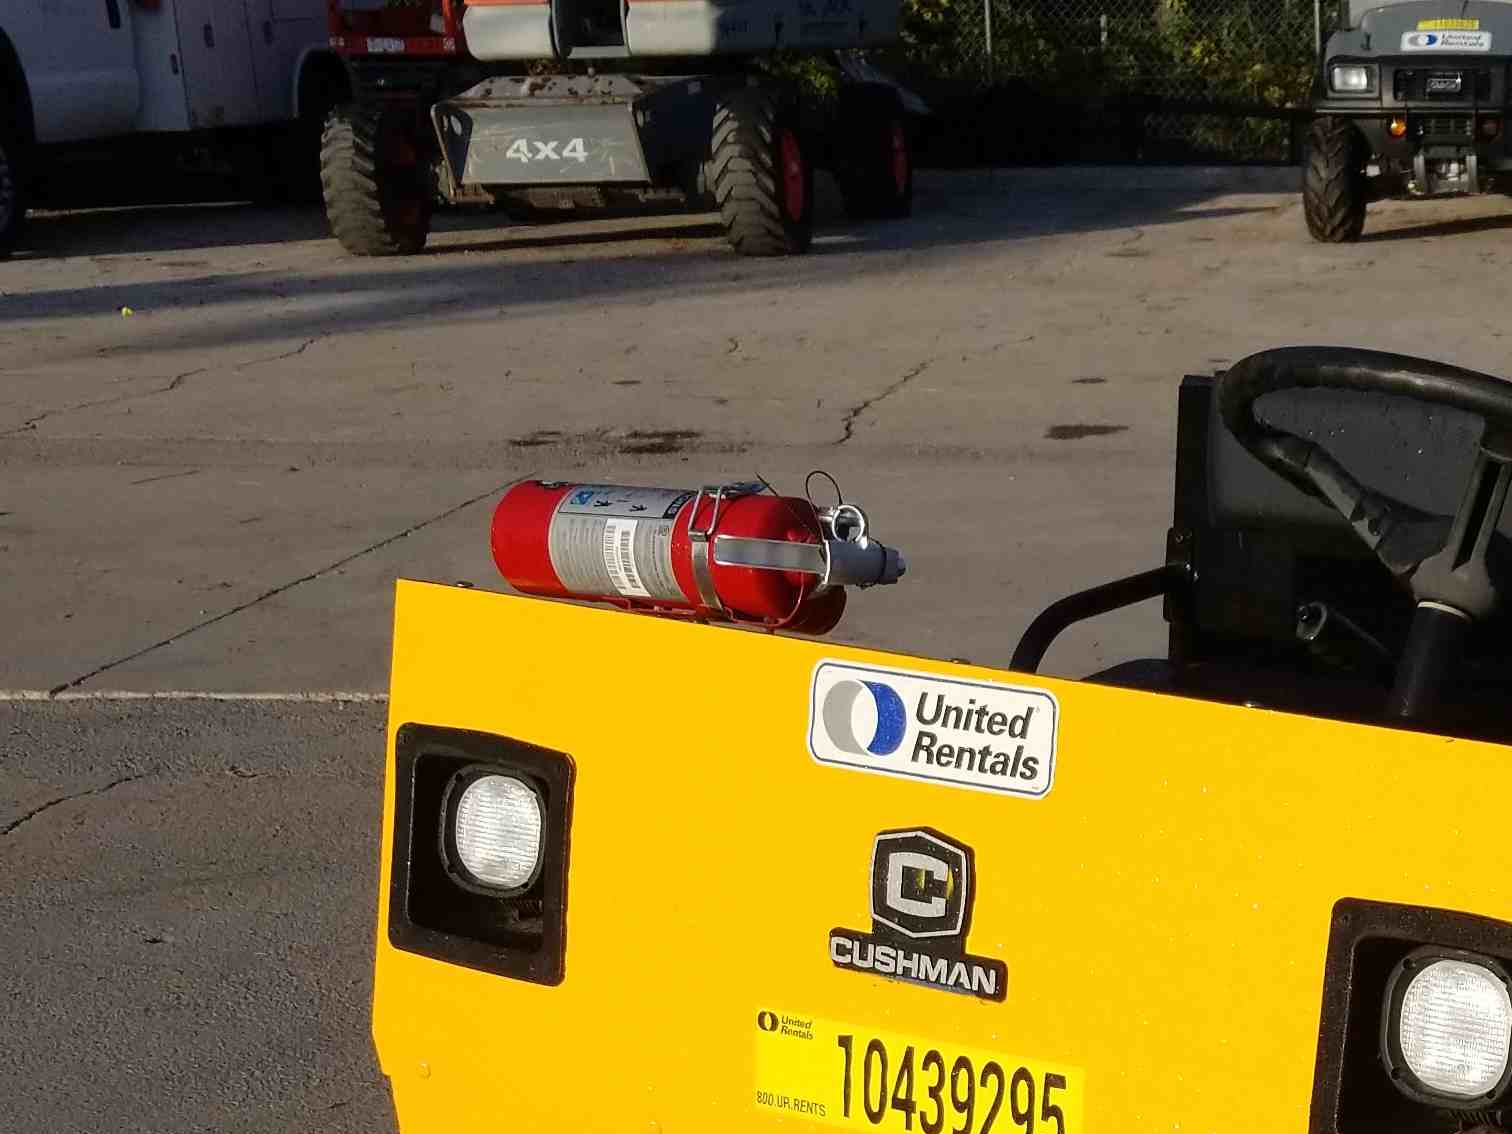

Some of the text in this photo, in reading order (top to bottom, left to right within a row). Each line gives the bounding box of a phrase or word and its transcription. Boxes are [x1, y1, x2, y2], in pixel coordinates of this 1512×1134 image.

[505, 136, 588, 164] 4x4
[914, 690, 1036, 739] United
[910, 731, 1040, 781] Rentals
[829, 935, 999, 995] CUSHMAN
[780, 1025, 814, 1040] Rentals
[781, 1015, 813, 1030] United
